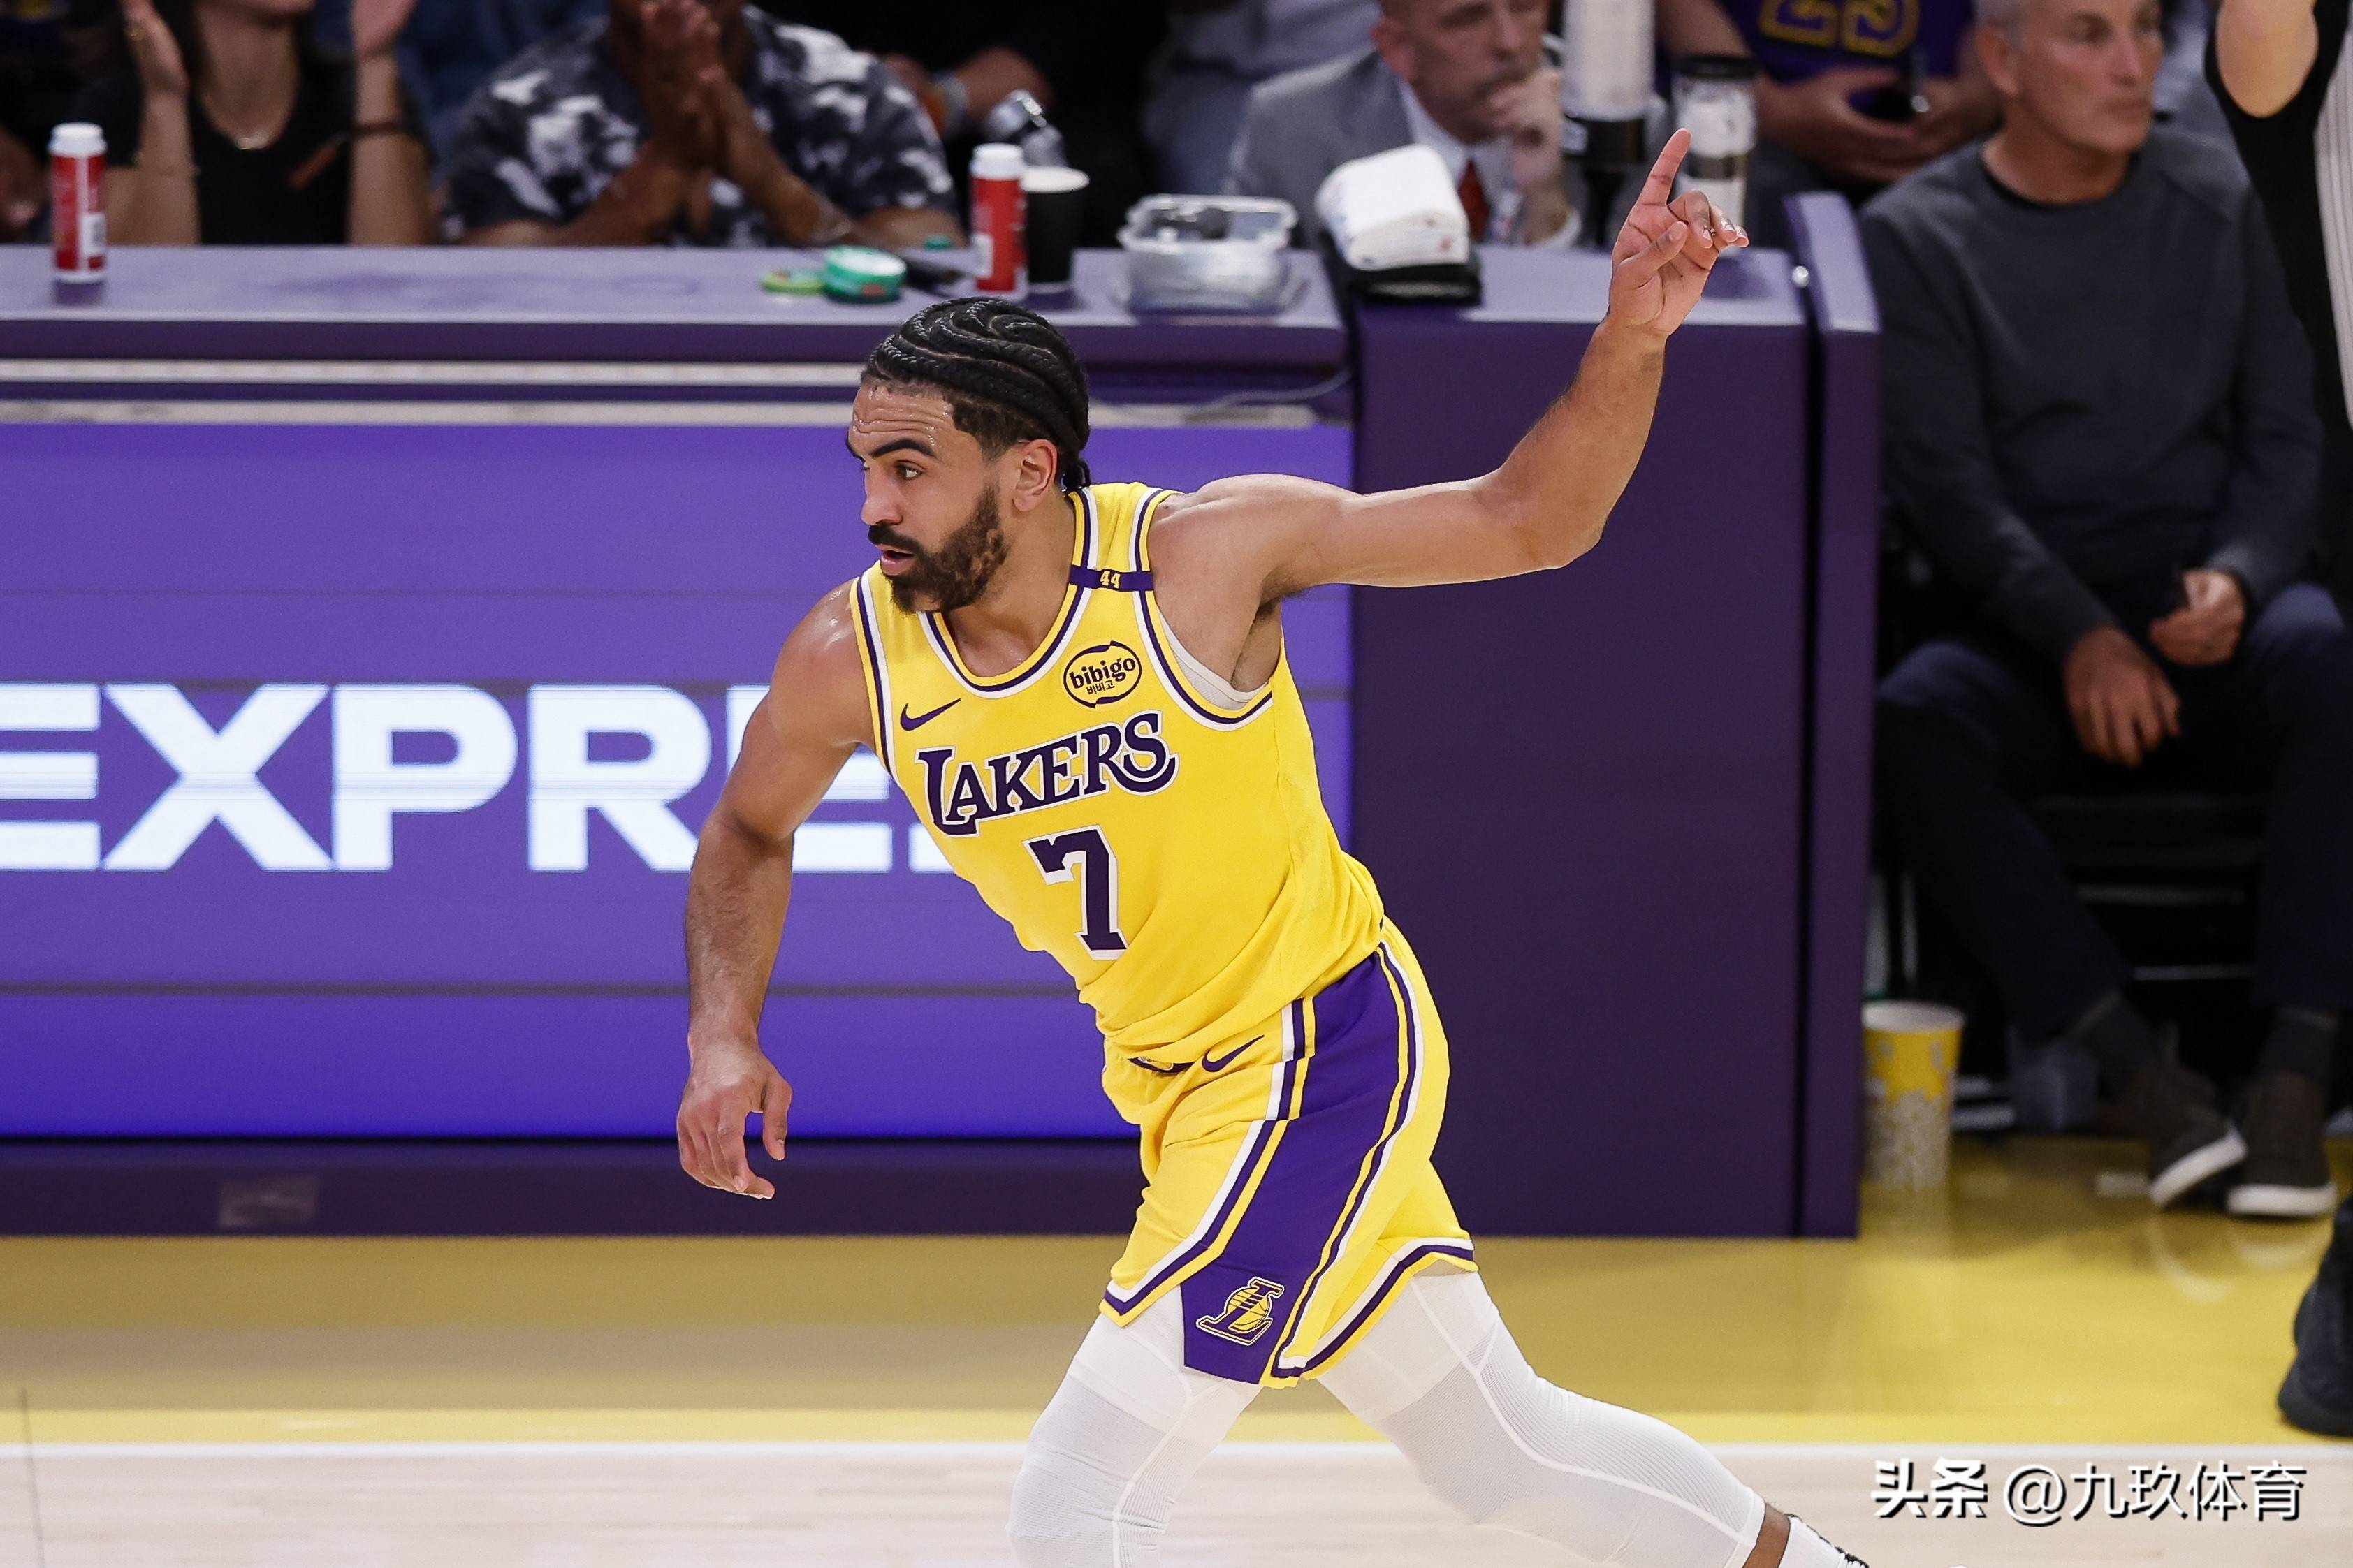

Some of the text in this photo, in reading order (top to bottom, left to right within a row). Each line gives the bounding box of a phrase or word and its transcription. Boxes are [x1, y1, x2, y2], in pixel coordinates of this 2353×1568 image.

[1100, 571, 1121, 589] 44
[1069, 657, 1136, 689] bibigo
[1086, 680, 1116, 695] 비비고
[915, 711, 1179, 837] LAKERS
[1023, 826, 1129, 960] 7
